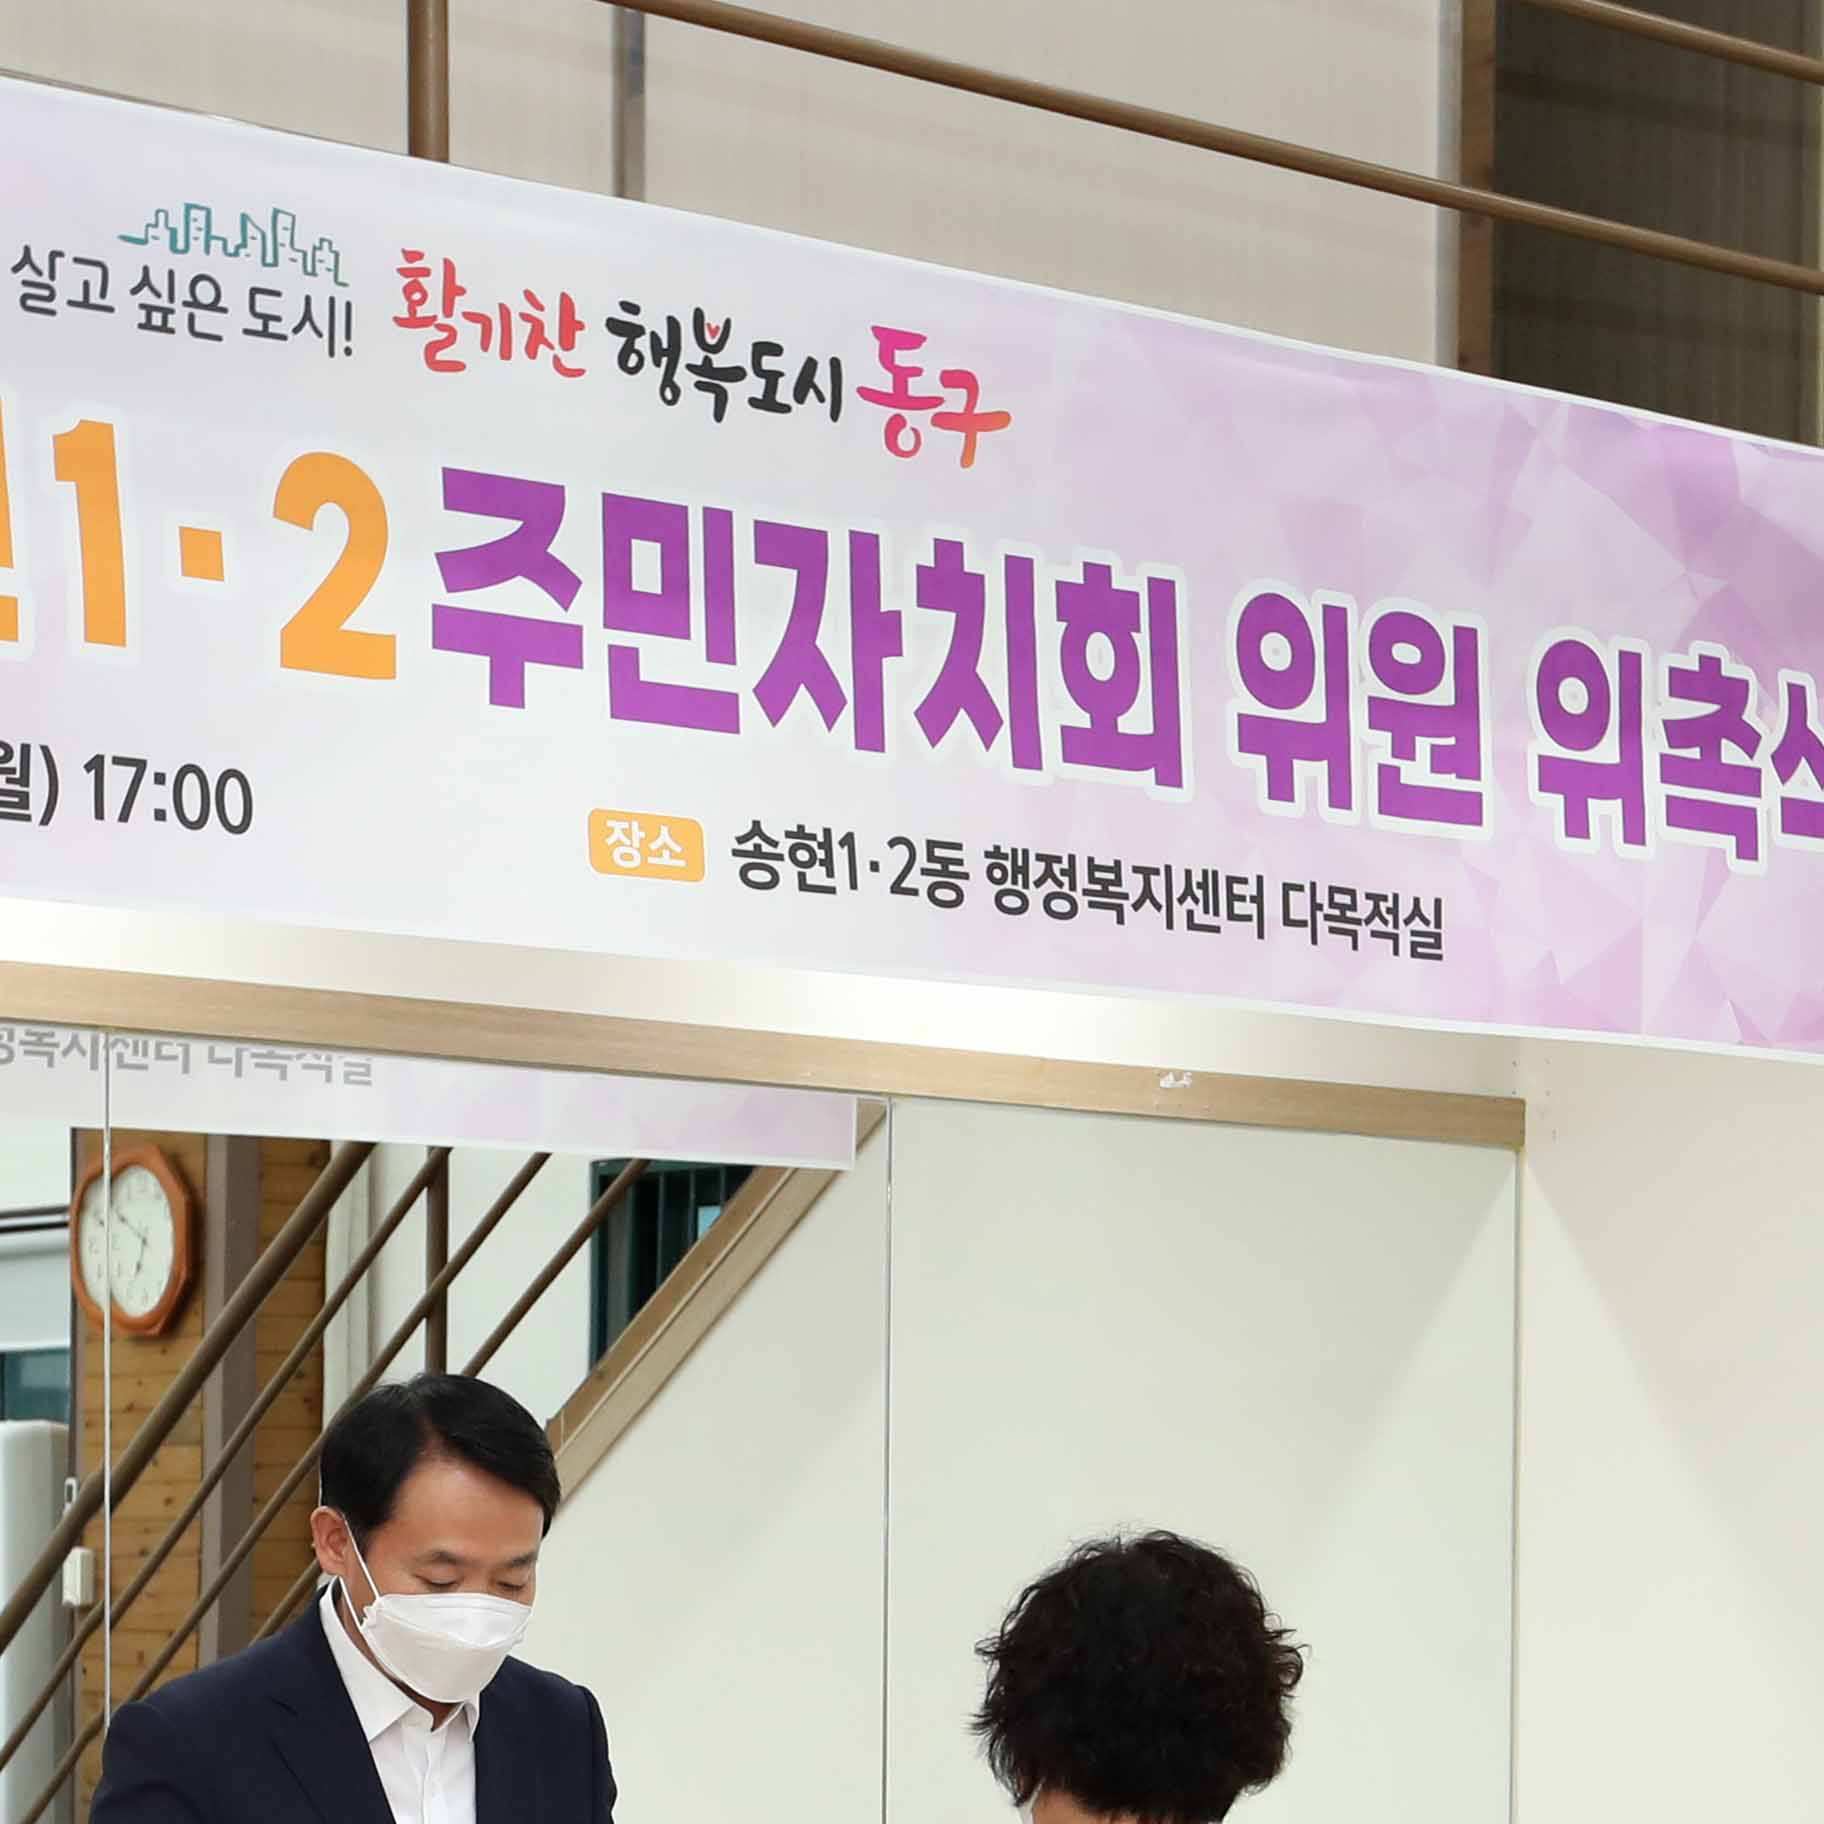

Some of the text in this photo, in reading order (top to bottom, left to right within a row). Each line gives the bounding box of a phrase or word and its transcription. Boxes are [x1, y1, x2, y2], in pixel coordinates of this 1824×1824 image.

[10, 244, 1013, 469] 살고 싶은 도시! 활기찬 행복도시 동구
[431, 466, 1183, 789] 주민자치회
[1234, 590, 1486, 829] 위원
[82, 753, 254, 836] 17:00
[606, 818, 1444, 961] 장소 송현1·2동 행정복지센터 다목적실
